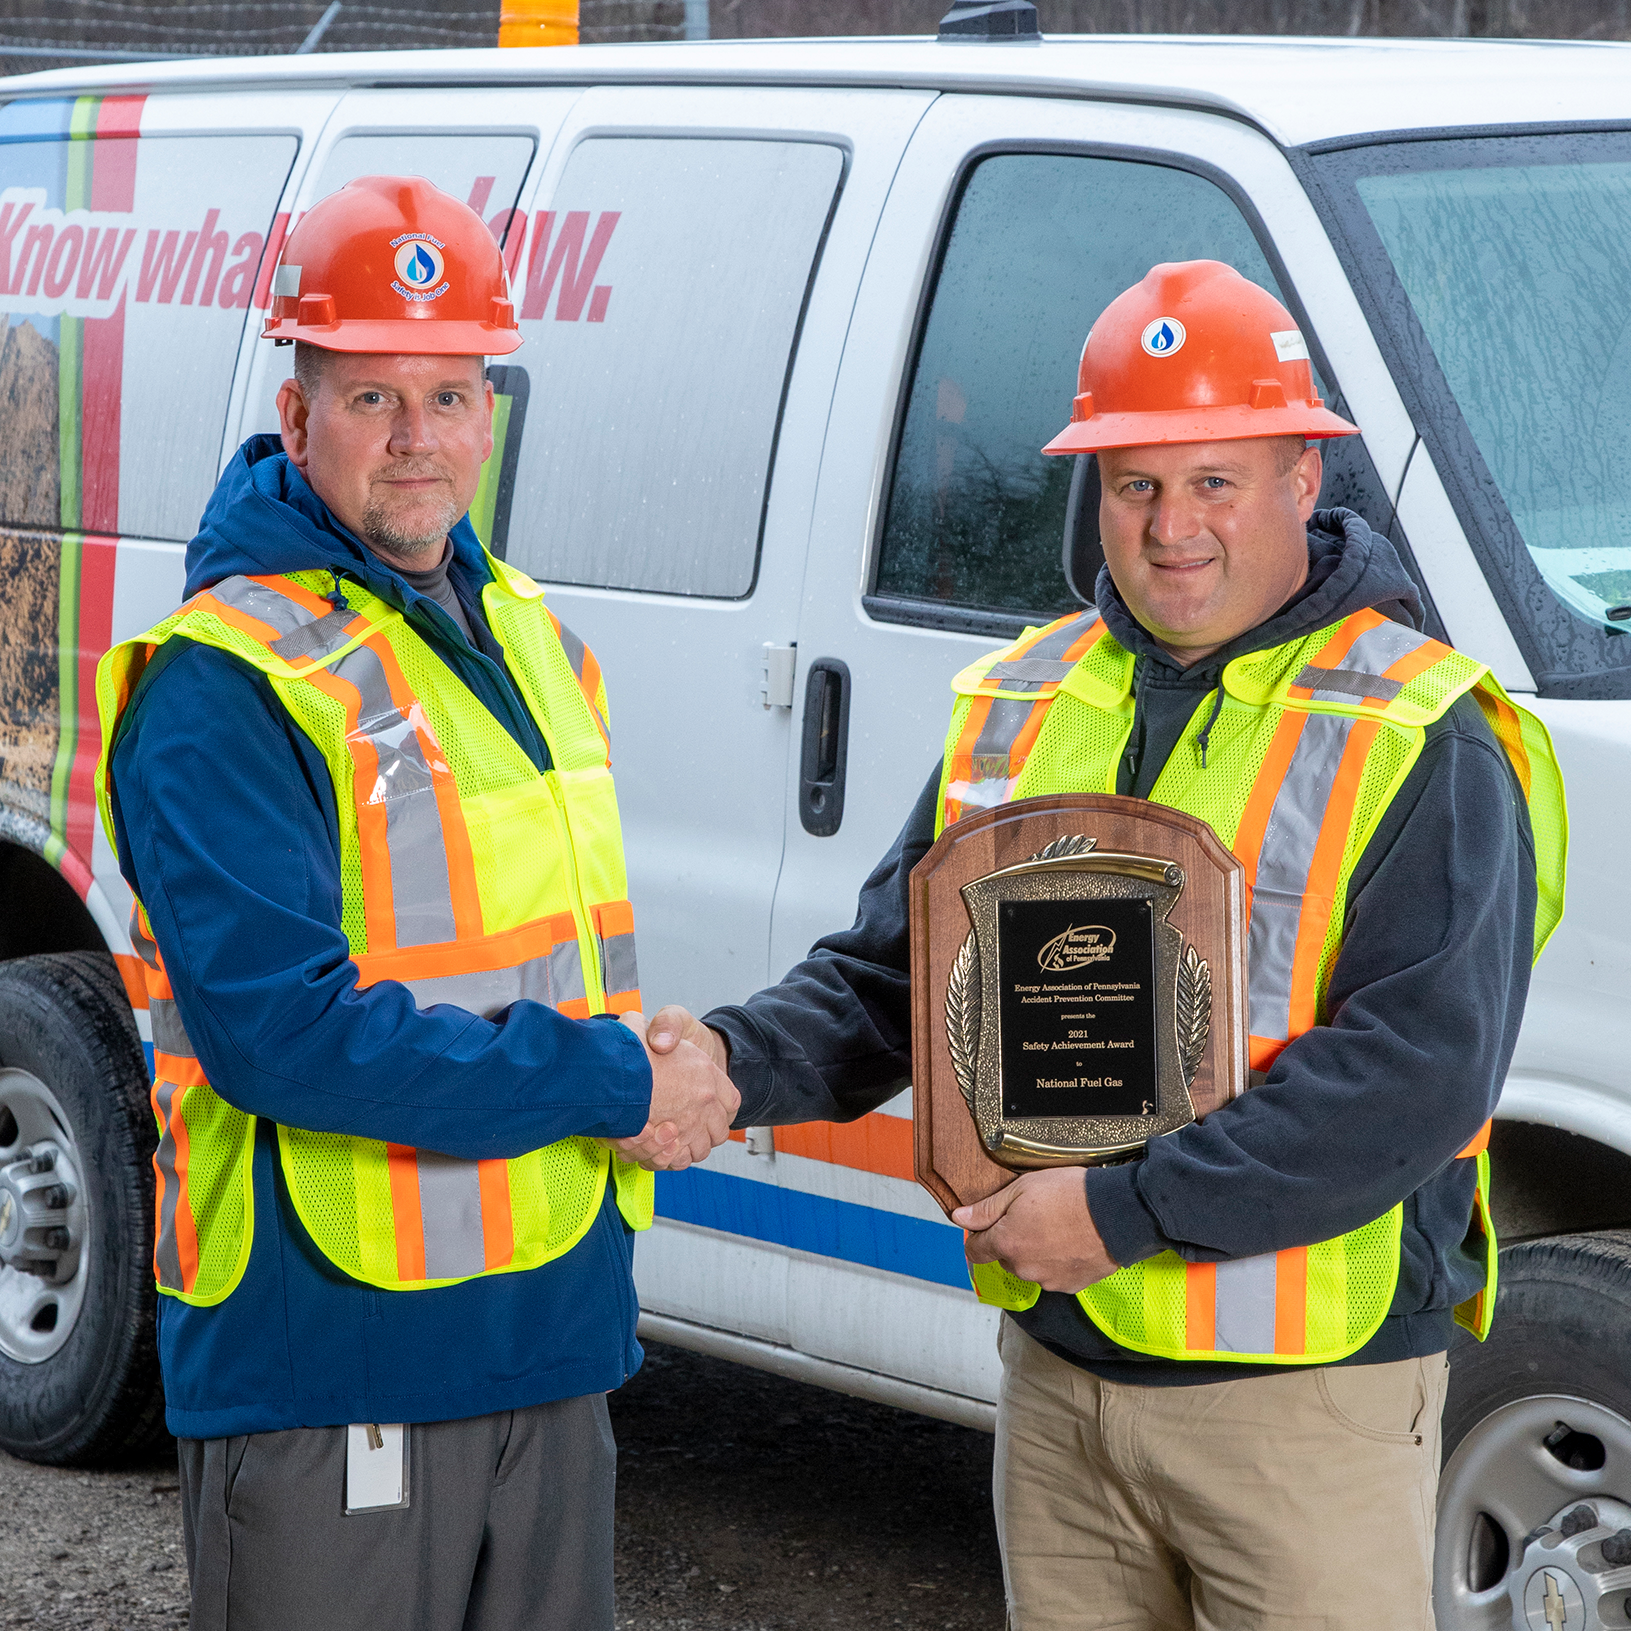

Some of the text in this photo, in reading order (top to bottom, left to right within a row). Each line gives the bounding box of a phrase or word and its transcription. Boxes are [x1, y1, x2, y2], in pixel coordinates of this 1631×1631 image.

[390, 233, 445, 248] National Fuel
[0, 202, 137, 300] Know
[391, 281, 413, 301] Safety
[422, 292, 436, 301] Job
[435, 282, 450, 296] One
[1068, 933, 1100, 943] Energy
[1062, 944, 1114, 954] Association
[1073, 954, 1110, 962] Pennsylvania
[1014, 982, 1141, 993] Energy Association of Pennsylvania
[1021, 994, 1135, 1004] Accident Prevention Committee
[1068, 1030, 1088, 1038] 2021
[1022, 1040, 1135, 1052] Safety Achievement Award
[1036, 1077, 1123, 1088] National Fuel Gas
